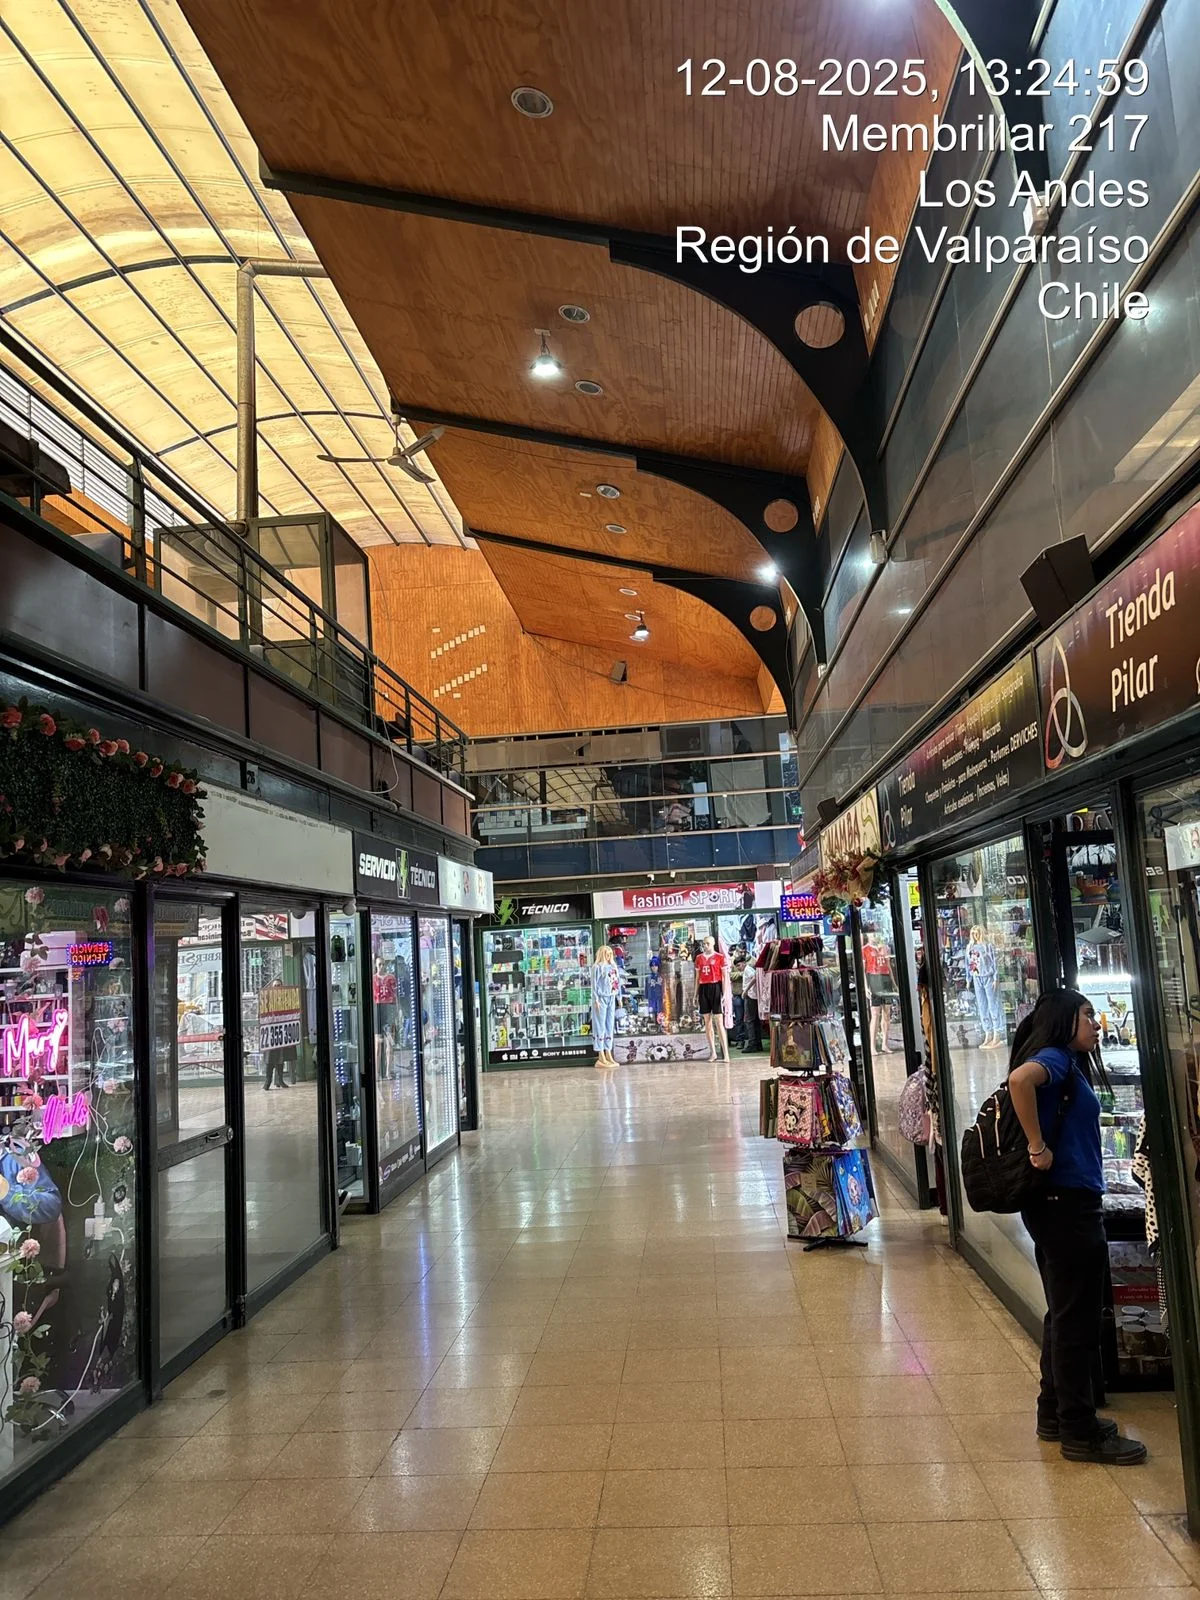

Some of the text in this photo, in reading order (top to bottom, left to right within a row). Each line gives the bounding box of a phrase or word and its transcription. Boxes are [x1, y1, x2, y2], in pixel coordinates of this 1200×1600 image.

[1105, 567, 1176, 649] Tienda
[1111, 654, 1159, 713] Pilar
[990, 744, 1010, 764] Perfumes
[1010, 721, 1038, 752] DERVICHES
[359, 853, 436, 889] SERVICIO TÉCNICO
[521, 903, 570, 916] TÉCNICO
[632, 892, 684, 909] fashion
[789, 908, 821, 917] TECNIC
[261, 1026, 270, 1049] 22
[270, 1024, 283, 1048] 355
